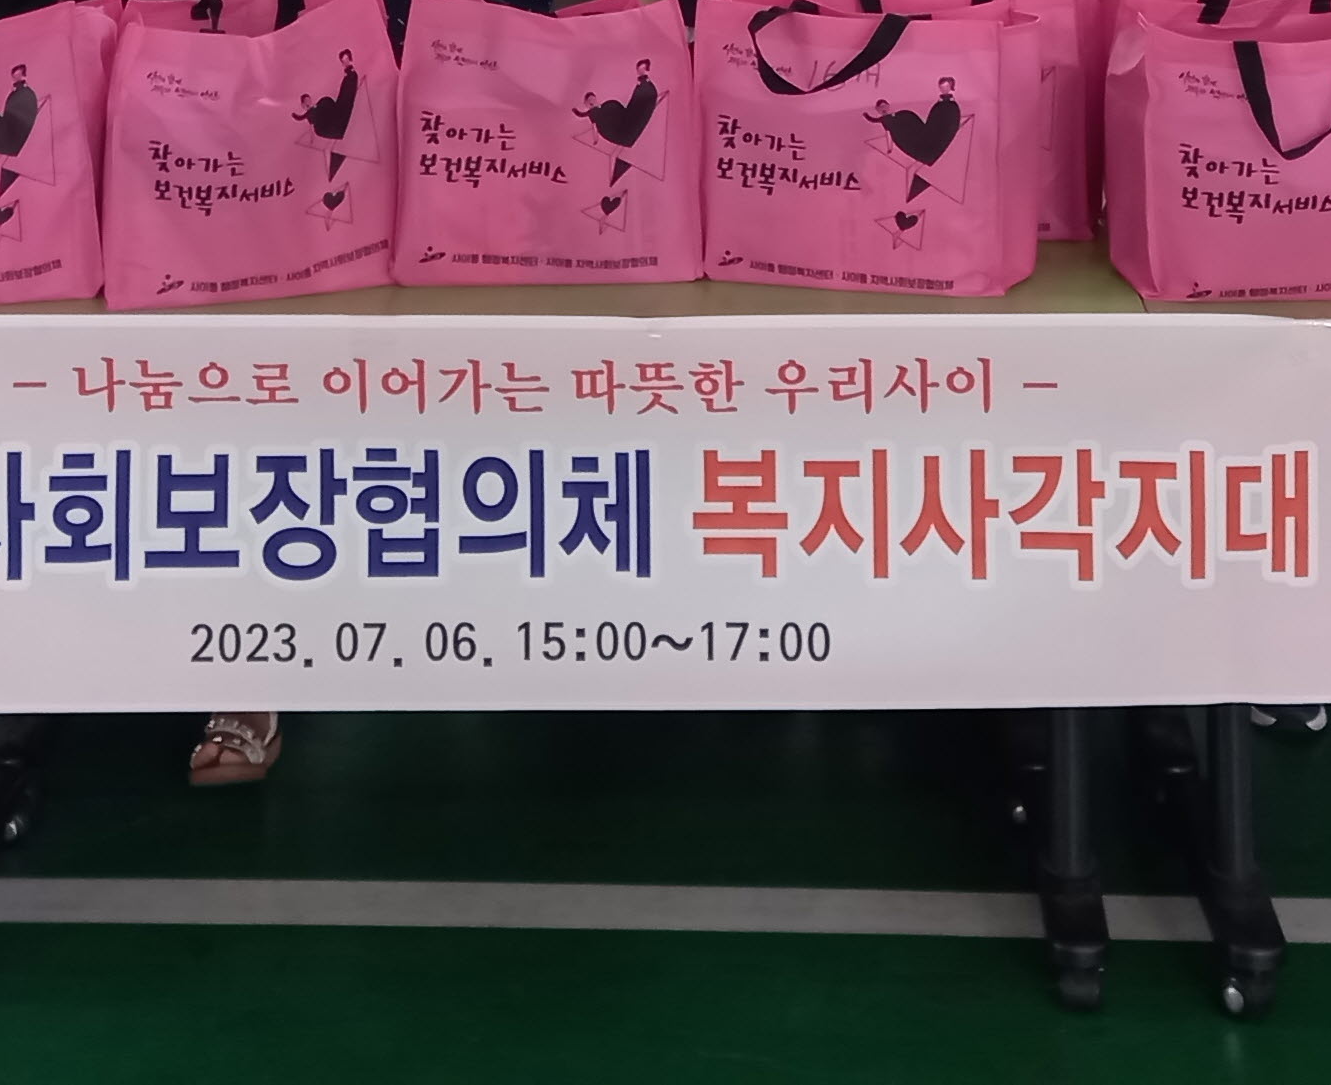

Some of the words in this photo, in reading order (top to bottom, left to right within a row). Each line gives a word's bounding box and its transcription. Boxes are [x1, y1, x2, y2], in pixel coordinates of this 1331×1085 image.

[419, 110, 517, 151] 찾아가는
[716, 114, 807, 160] 찾아가는
[148, 140, 245, 178] 찾아가는
[418, 152, 568, 189] 보건복지서비스
[716, 156, 863, 195] 보건복지서비스
[1179, 143, 1280, 184] 찾아가는
[153, 174, 296, 216] 보건복지서비스
[72, 355, 300, 414] 나눔으로
[324, 355, 550, 414] 이어가는
[572, 356, 745, 415] 따뜻한
[763, 356, 993, 415] 우리사이
[691, 448, 1311, 583] 복지사각지대
[190, 622, 315, 668] 2023.
[335, 623, 403, 668] 07.
[424, 623, 494, 668] 06.
[520, 620, 832, 664] 15:00~17:00
